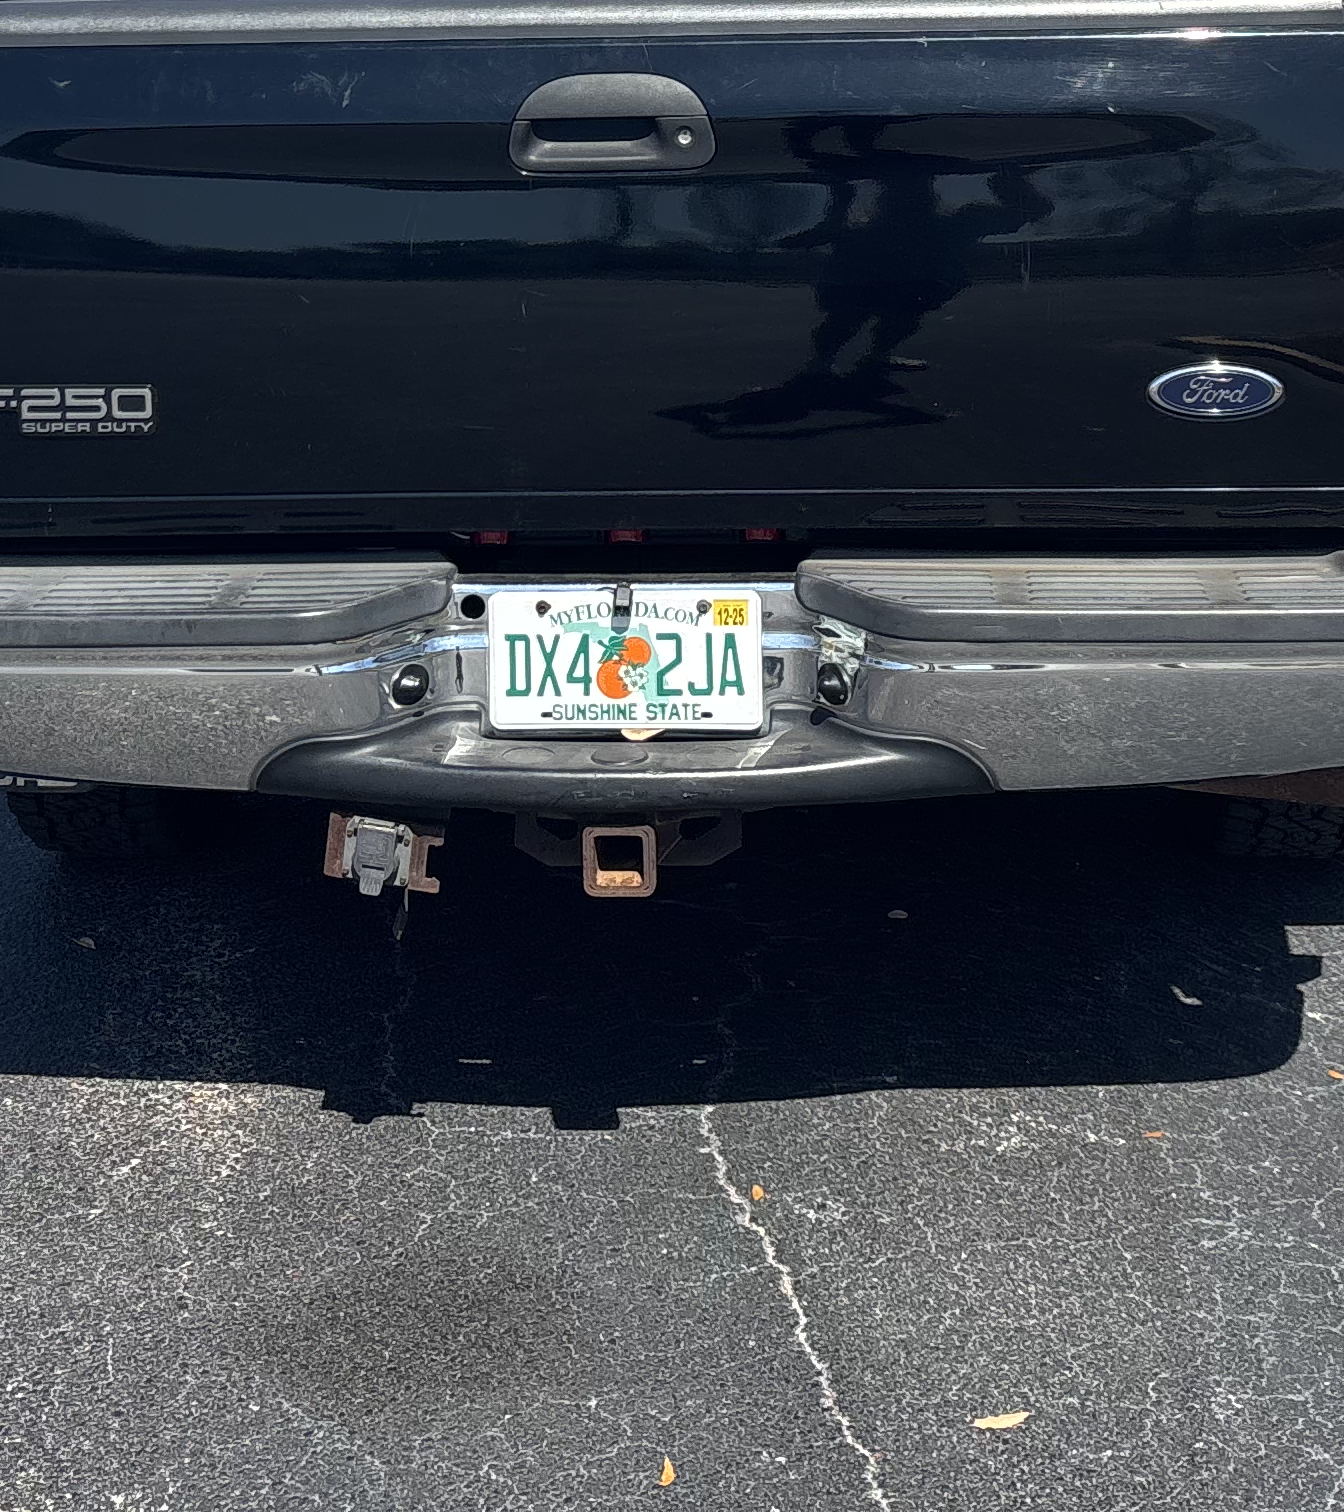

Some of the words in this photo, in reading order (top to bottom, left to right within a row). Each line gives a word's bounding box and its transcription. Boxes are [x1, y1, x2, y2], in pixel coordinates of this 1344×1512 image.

[1182, 375, 1251, 404] Ford
[22, 422, 91, 433] SUPER
[97, 421, 154, 433] DUTY
[550, 601, 702, 627] MYFLODA.COM
[717, 607, 744, 626] 12-25
[504, 633, 592, 697] DX4
[655, 632, 745, 696] 2JA
[552, 703, 638, 721] SUNSHINE
[645, 703, 702, 721] STATE
